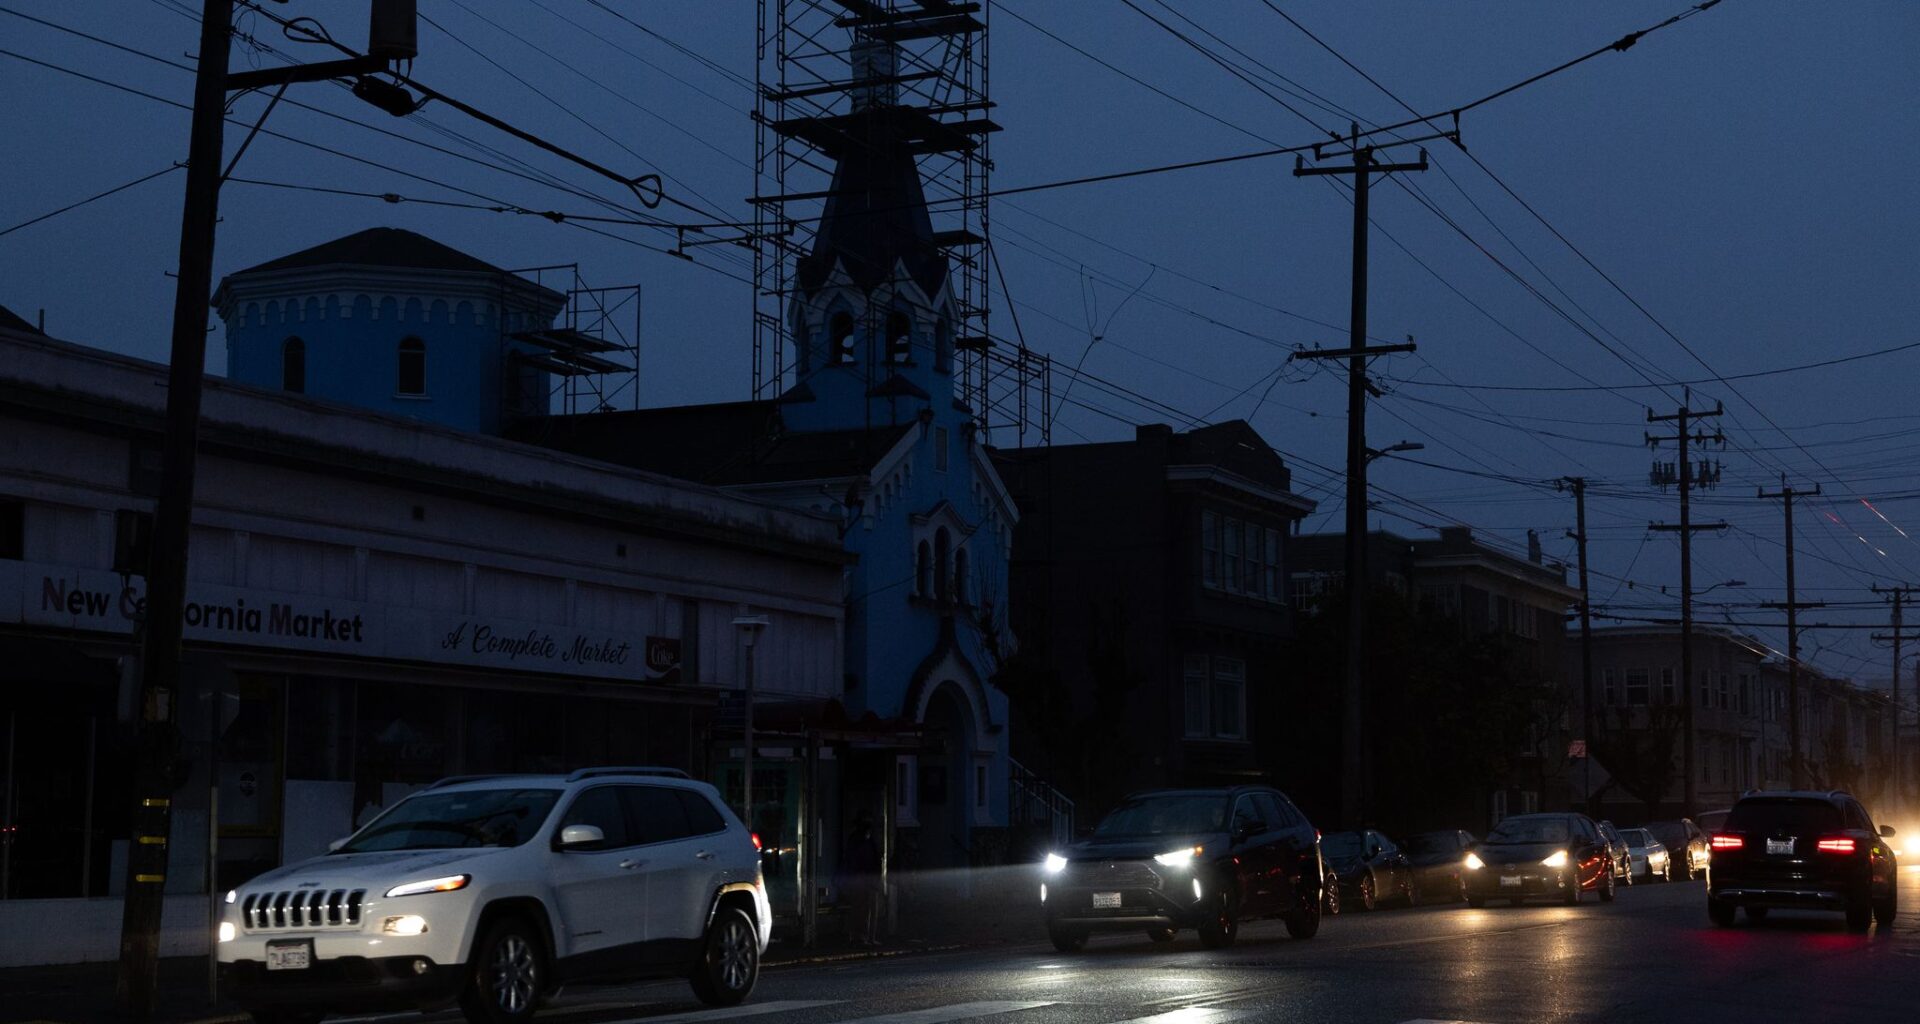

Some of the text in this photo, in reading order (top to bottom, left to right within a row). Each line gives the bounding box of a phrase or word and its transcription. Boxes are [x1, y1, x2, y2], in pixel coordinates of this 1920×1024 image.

[41, 576, 362, 642] New Caornia Market
[442, 622, 631, 665] A Complete Market
[651, 644, 674, 665] Coke
